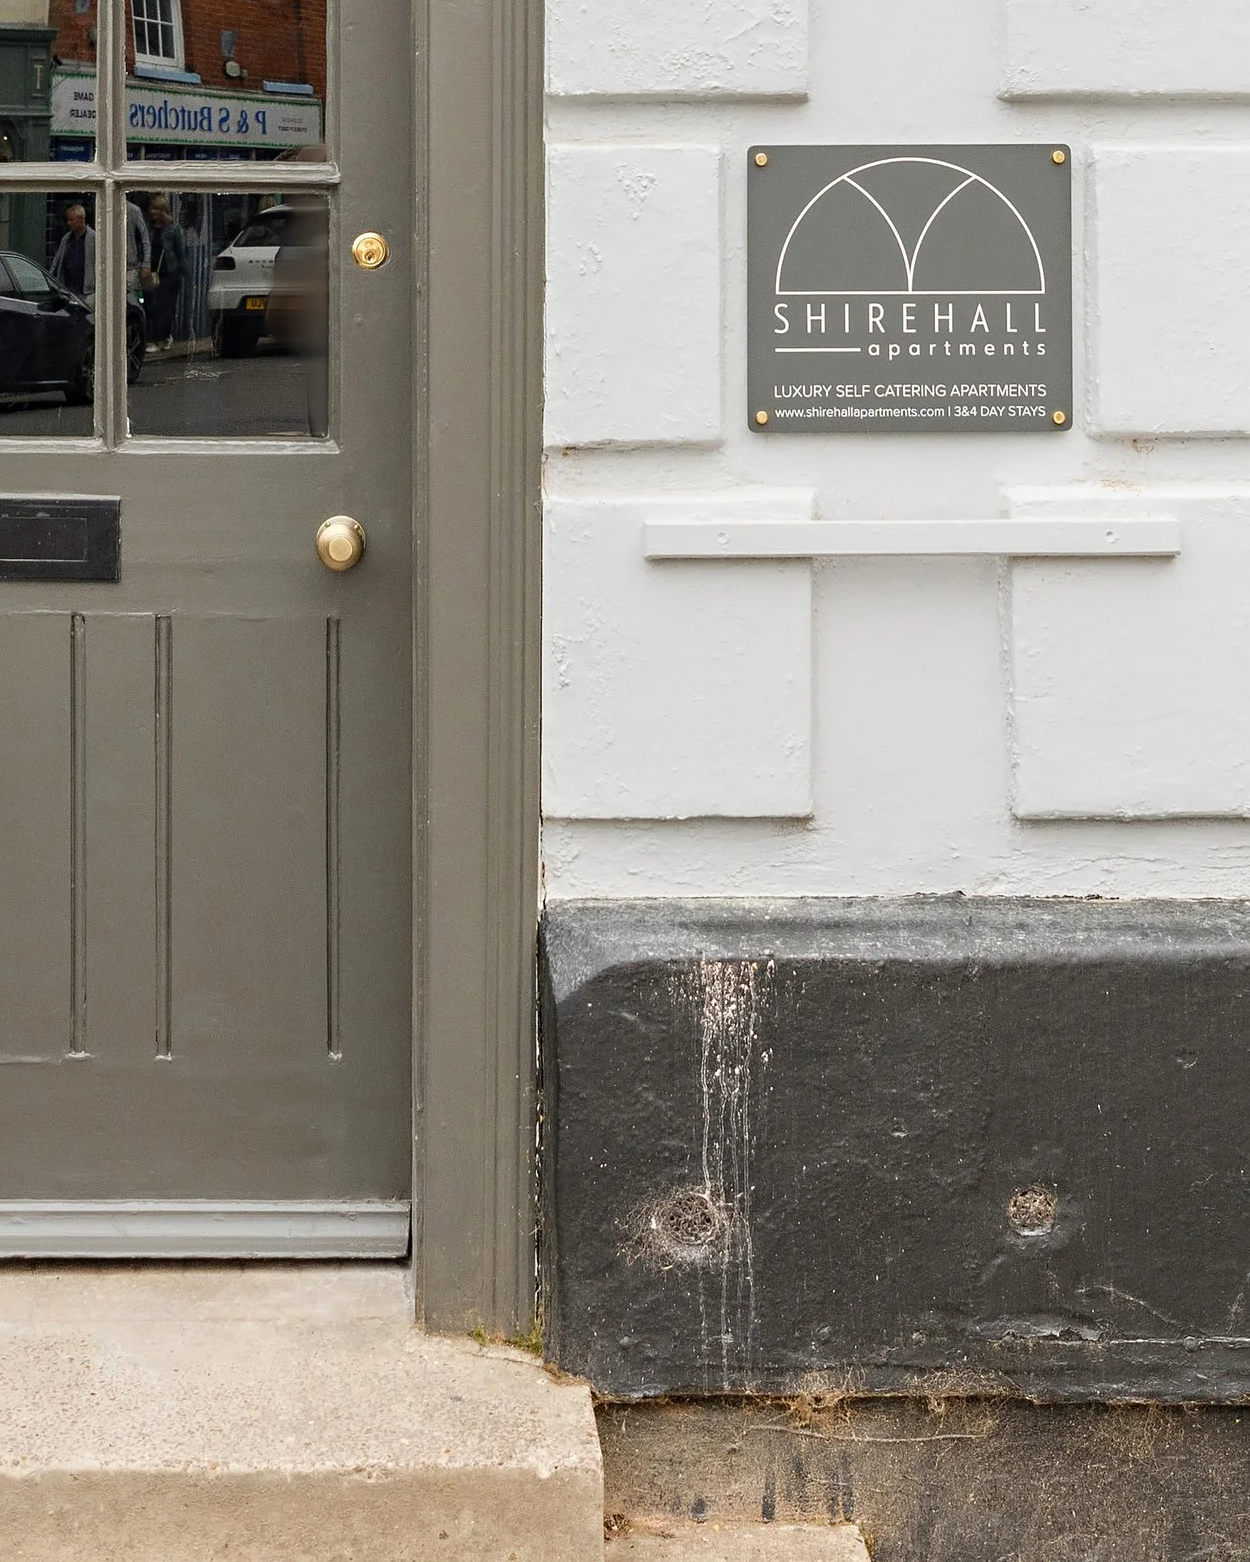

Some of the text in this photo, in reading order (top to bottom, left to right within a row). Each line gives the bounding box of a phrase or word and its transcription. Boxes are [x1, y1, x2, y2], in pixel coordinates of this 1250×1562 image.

[773, 302, 1047, 334] SHIREHALL
[868, 340, 1046, 361] apartments
[774, 383, 1047, 398] LUXURY SELF CATERING APARTMENTS
[774, 406, 945, 420] www.shirehallapartments.com
[953, 405, 978, 417] 3&4
[980, 405, 1006, 417] DAY
[1007, 405, 1046, 417] STAYS
